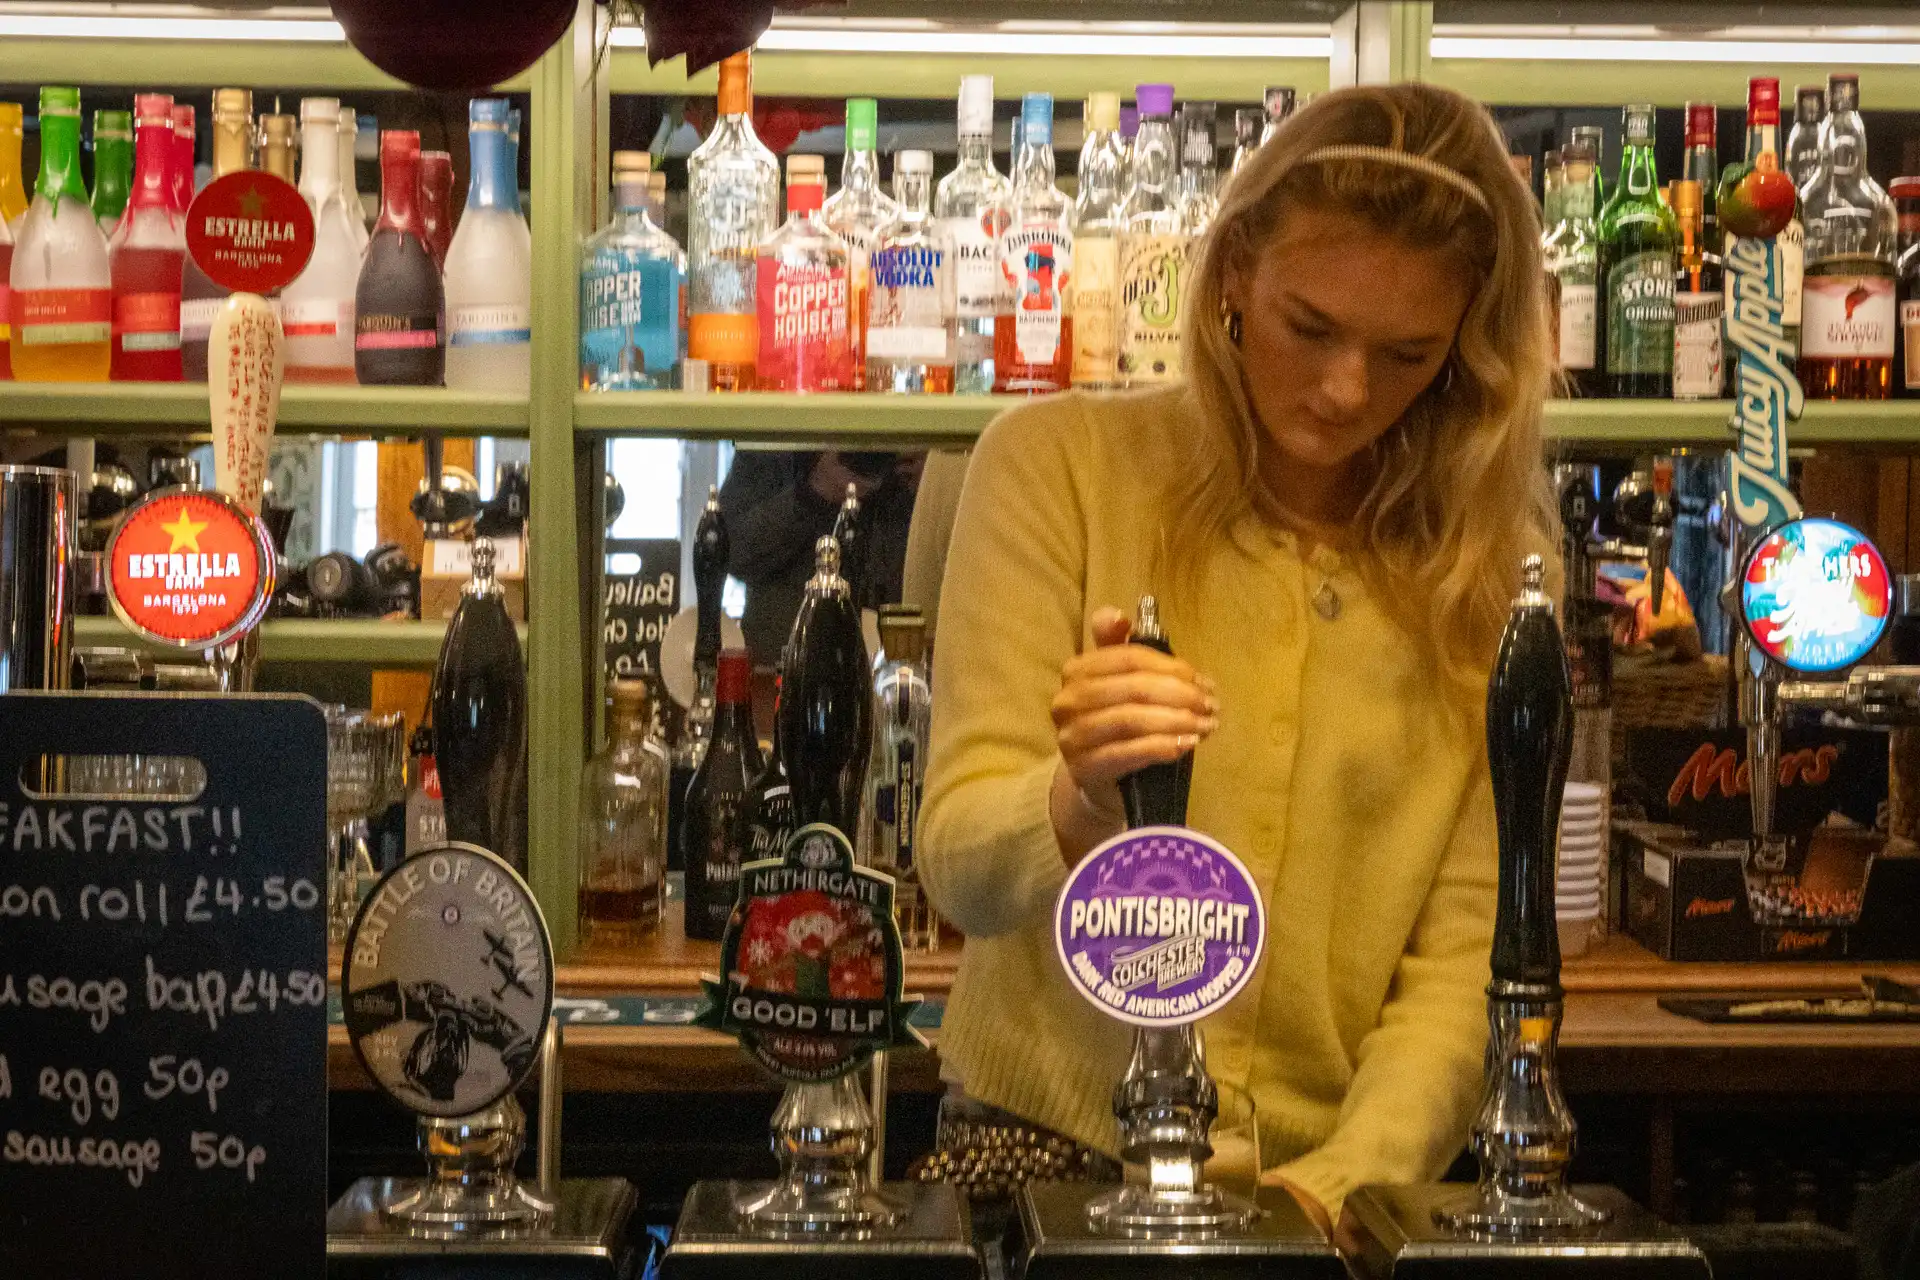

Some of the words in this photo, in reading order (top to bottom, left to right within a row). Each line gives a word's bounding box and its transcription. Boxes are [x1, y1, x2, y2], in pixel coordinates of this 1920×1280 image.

[204, 215, 296, 242] ESTRELLA
[585, 269, 642, 309] OPPER
[874, 265, 935, 288] VODKA
[774, 278, 846, 317] COPPER
[774, 307, 831, 342] HOUSE
[1722, 236, 1804, 421] Apple
[1726, 363, 1803, 527] Juicy
[128, 552, 241, 579] ESTRELLA
[164, 574, 205, 590] DAMM
[142, 593, 227, 608] BARCELONA
[0, 884, 61, 921] on
[80, 878, 168, 927] roll
[184, 875, 320, 924] £4.50
[754, 866, 878, 903] NETHERGATE
[353, 863, 427, 969] BATTLE
[428, 854, 473, 885] OF
[1069, 895, 1250, 946] PONTISBRIGHT
[1111, 936, 1206, 989] COLCHESTER
[145, 953, 227, 1032] bap
[1097, 980, 1127, 1008] AND
[1125, 992, 1200, 1018] AMERICAN
[732, 996, 818, 1030] GOOD
[38, 1065, 119, 1126] egg
[144, 1054, 230, 1114] 50p
[4, 1129, 162, 1188] sausage
[190, 1130, 267, 1184] 50p
